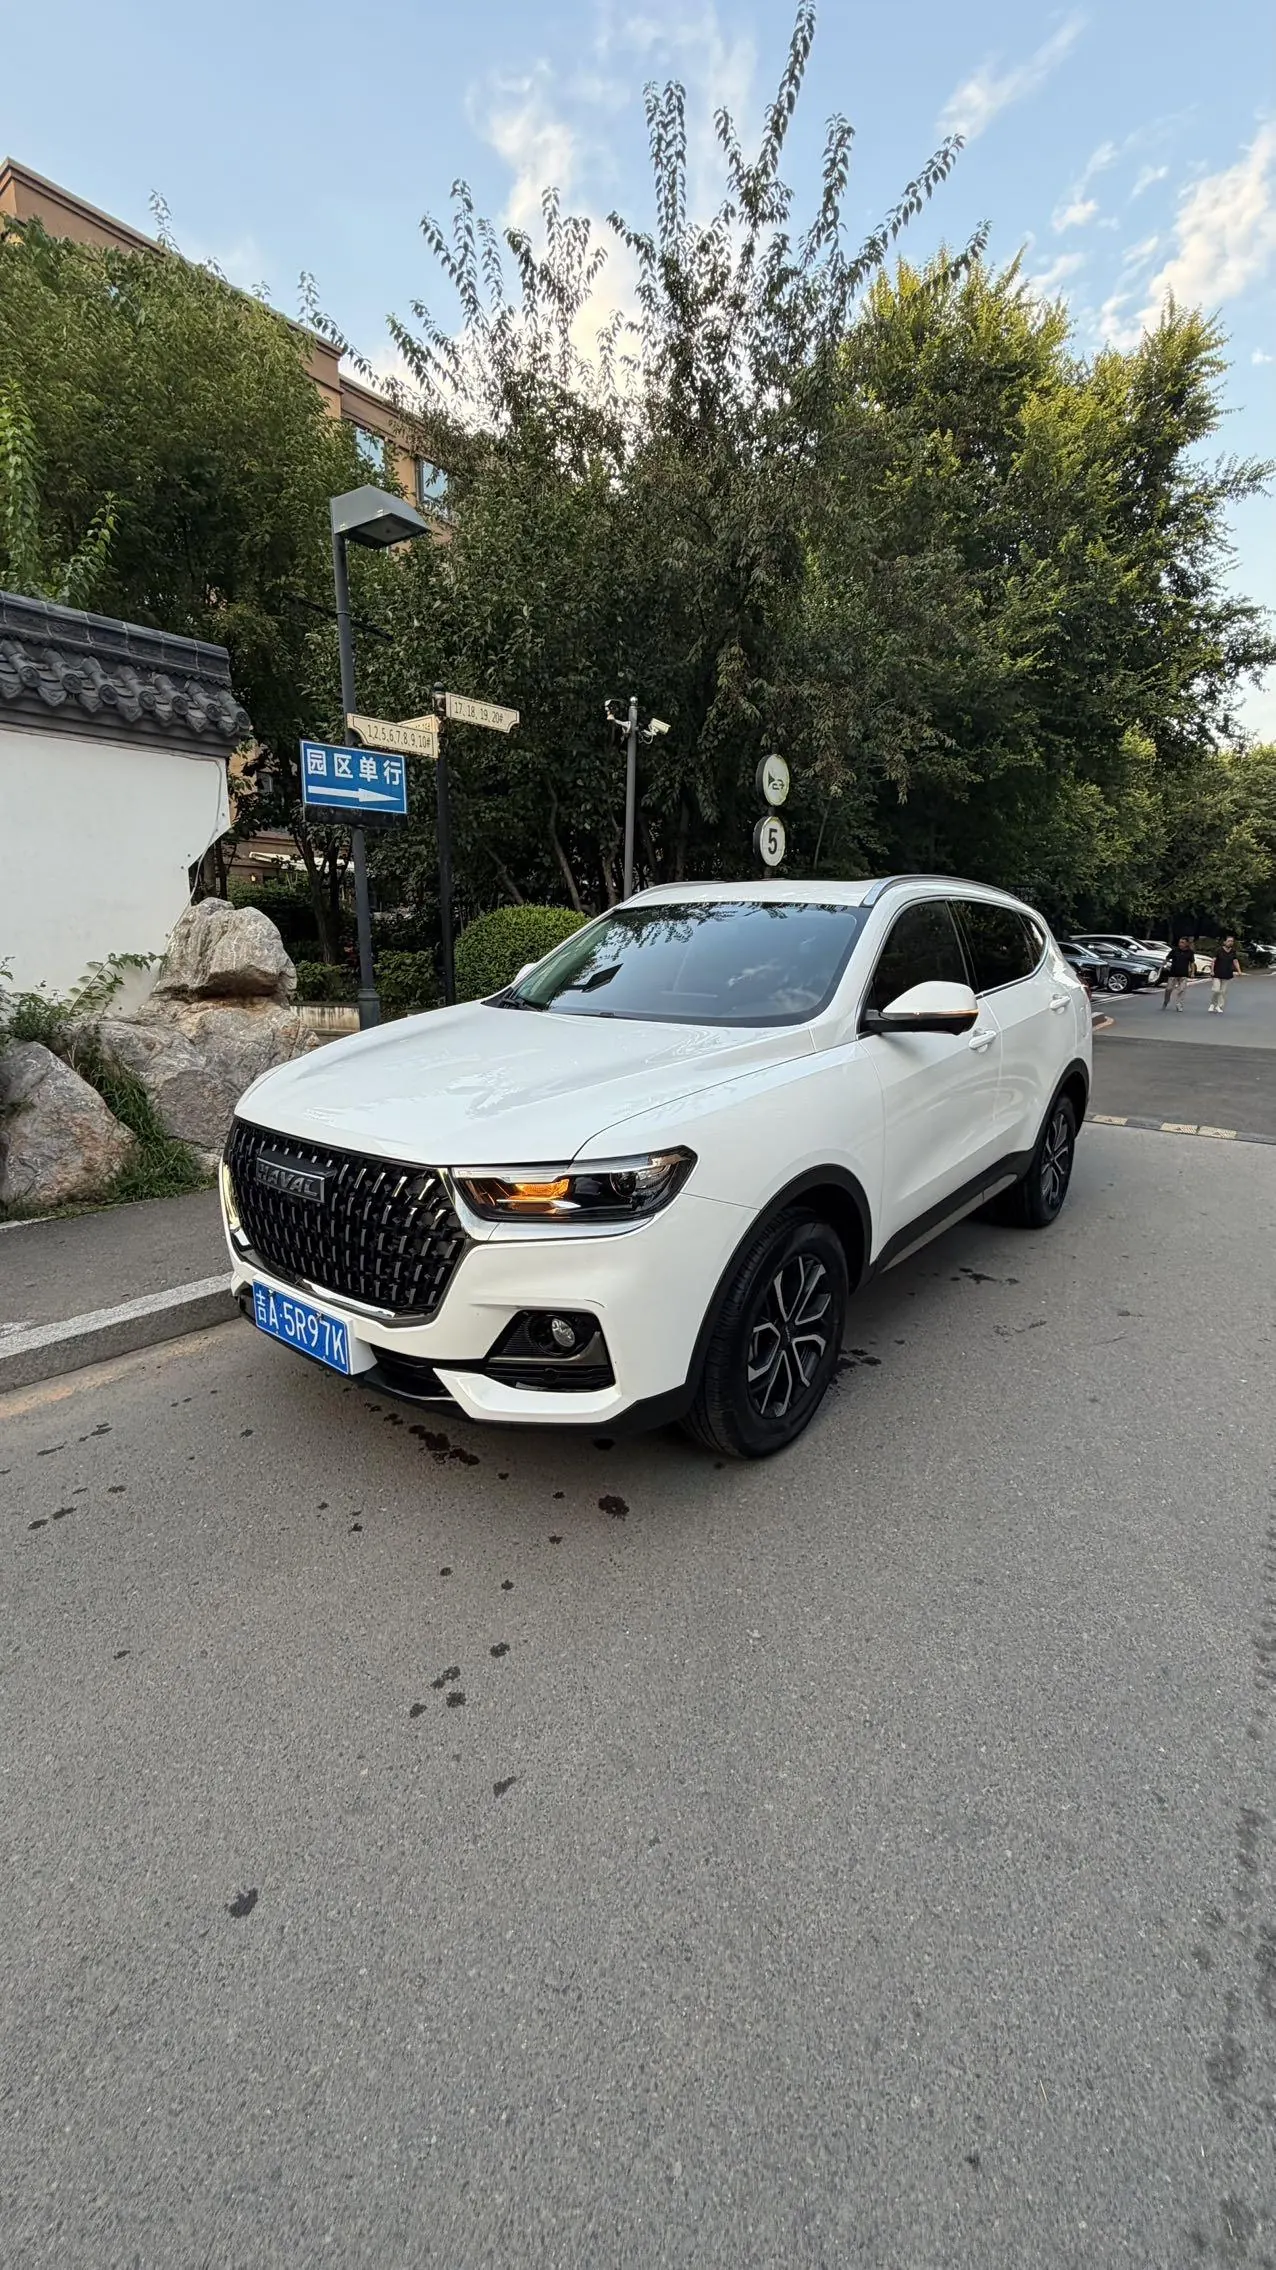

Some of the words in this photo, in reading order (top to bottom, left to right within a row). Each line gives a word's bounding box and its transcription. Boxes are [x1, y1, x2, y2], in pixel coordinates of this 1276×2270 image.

[306, 748, 402, 785] 园区单行
[767, 828, 778, 855] 5
[258, 1163, 318, 1197] HAVAL
